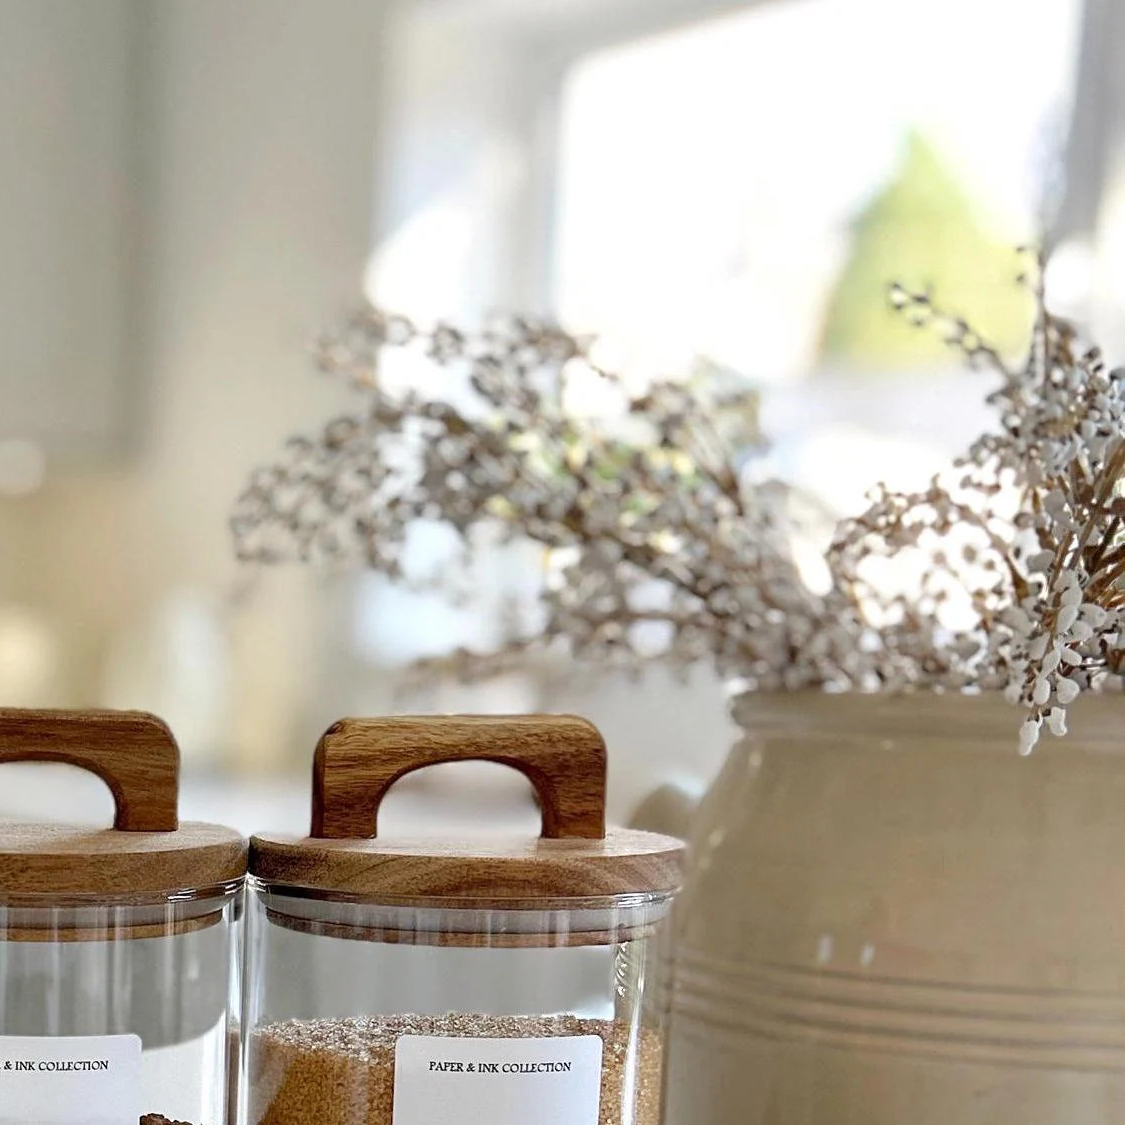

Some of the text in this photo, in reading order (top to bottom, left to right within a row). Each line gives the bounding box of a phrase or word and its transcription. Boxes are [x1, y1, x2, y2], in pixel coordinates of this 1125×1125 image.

[4, 1060, 13, 1071] &
[15, 1060, 36, 1071] INK
[38, 1059, 109, 1072] COLLECTION
[428, 1061, 572, 1074] PAPER & INK COLLECTION
